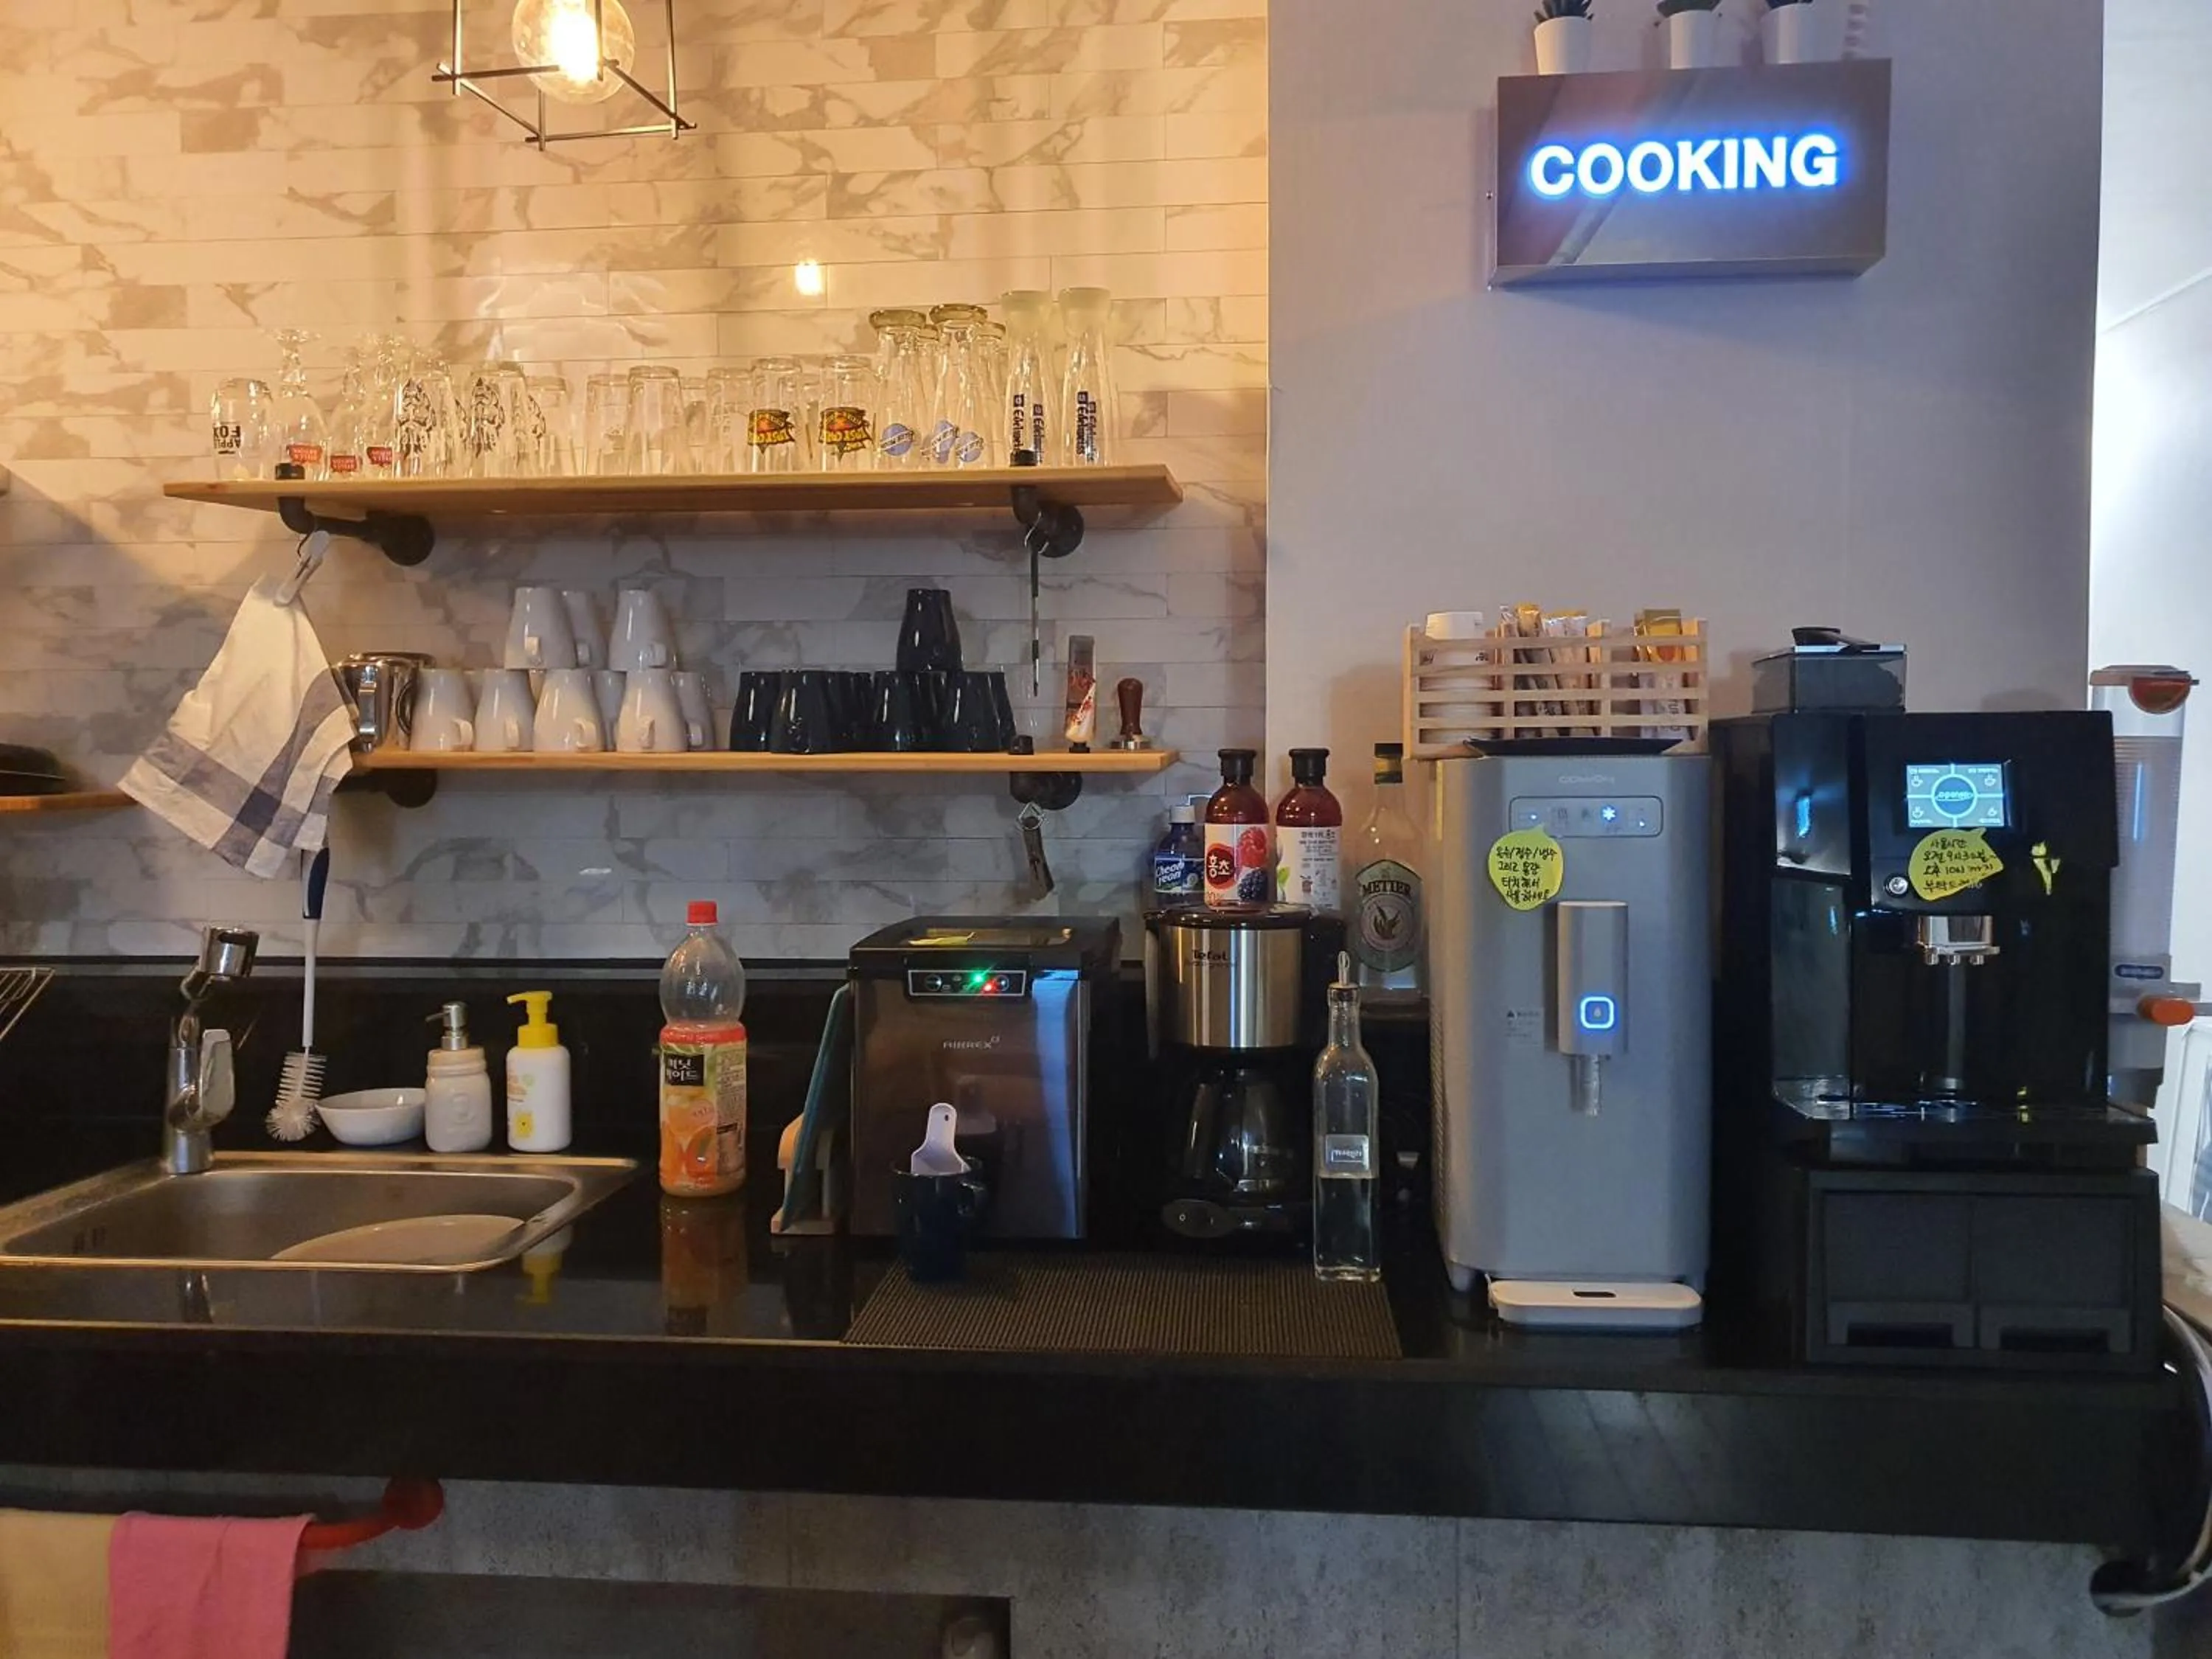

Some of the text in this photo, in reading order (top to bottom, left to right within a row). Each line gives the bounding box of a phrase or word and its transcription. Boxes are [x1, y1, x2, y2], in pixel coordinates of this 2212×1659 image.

[1530, 134, 1838, 195] COOKING
[1208, 854, 1231, 878] 홍초
[1362, 880, 1412, 900] METIER
[1192, 949, 1228, 961] Tefal
